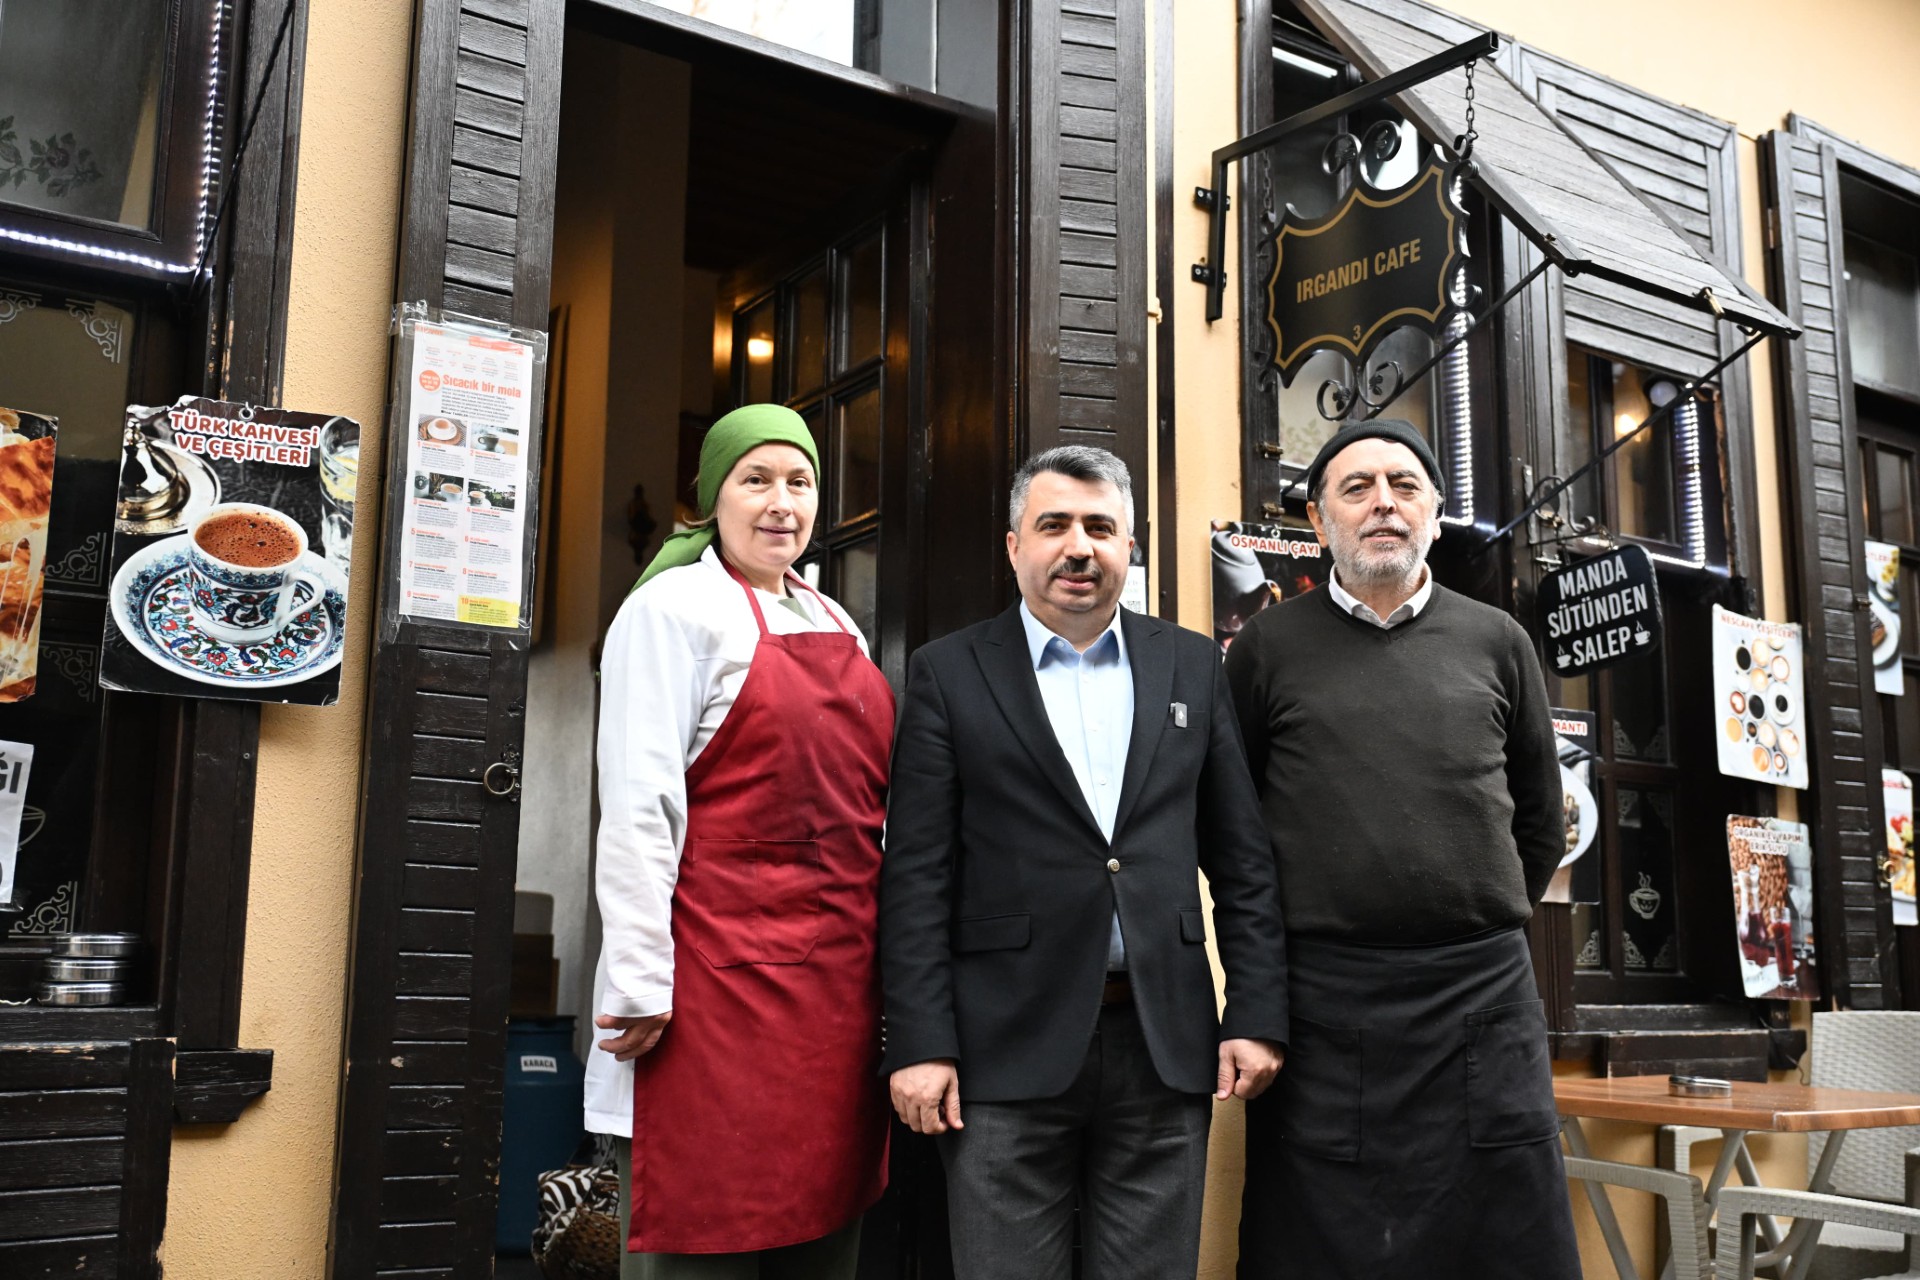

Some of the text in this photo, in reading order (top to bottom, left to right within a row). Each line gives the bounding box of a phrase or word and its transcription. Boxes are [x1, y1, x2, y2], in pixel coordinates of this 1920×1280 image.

[1296, 238, 1421, 304] IRGANDI CAFE
[1353, 324, 1361, 341] 3
[442, 374, 479, 391] Sıcacık
[481, 381, 496, 393] bir
[497, 385, 522, 398] mola
[170, 409, 321, 448] TÜRK KAHVESİ
[176, 434, 311, 467] VE ÇEŞİTLERİ
[1231, 535, 1320, 558] OSMANLI ÇAYI
[1558, 554, 1628, 600] MANDA
[1547, 583, 1648, 638] SÜTÜNDEN
[1572, 626, 1631, 667] SALEP
[1552, 719, 1587, 734] MANTI
